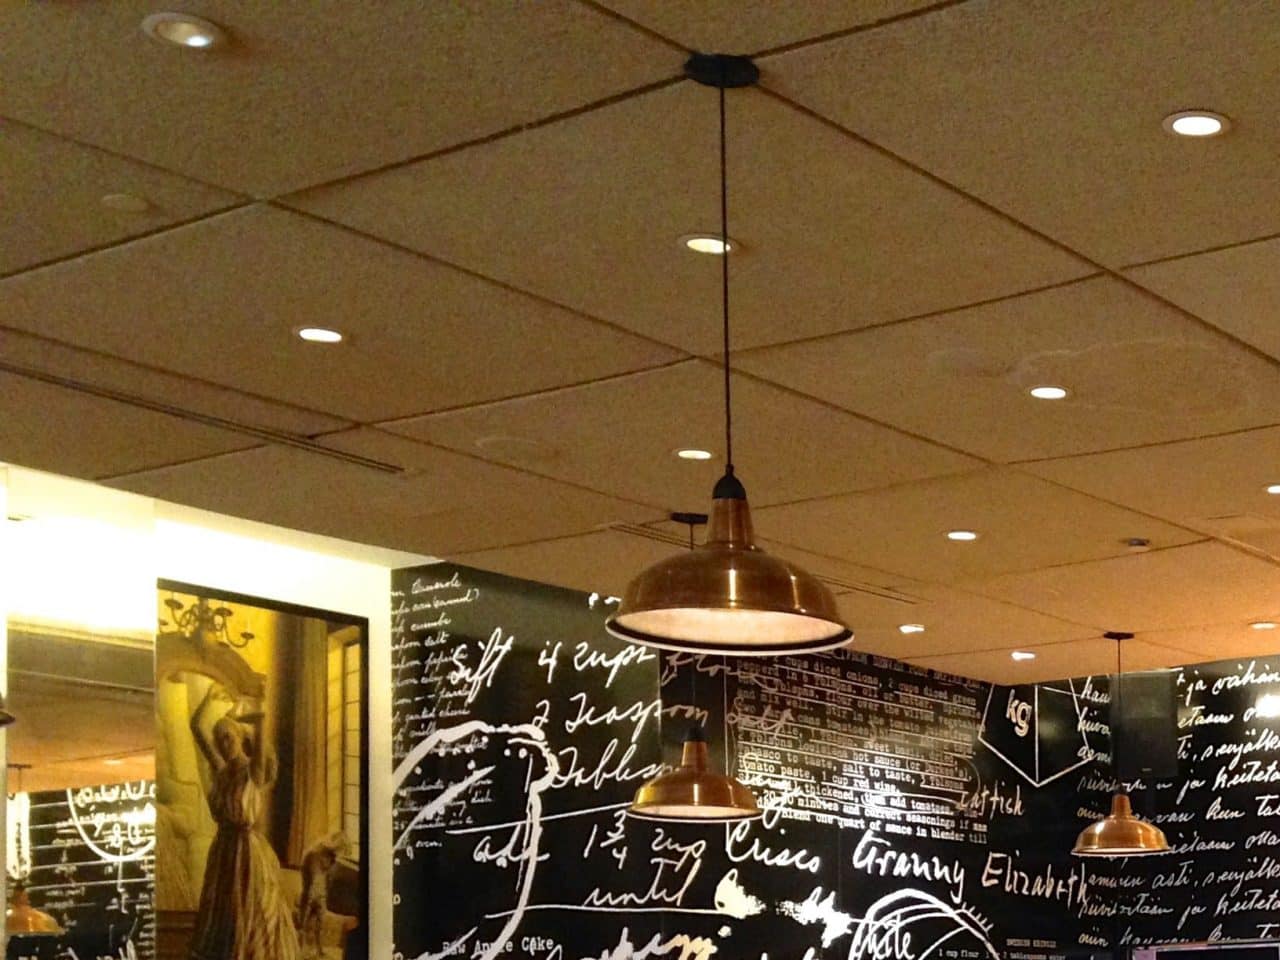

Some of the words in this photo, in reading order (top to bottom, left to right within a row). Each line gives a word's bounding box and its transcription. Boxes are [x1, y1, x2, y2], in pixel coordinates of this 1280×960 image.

[1005, 687, 1034, 739] kg
[780, 764, 816, 783] paste,
[831, 773, 850, 787] cup
[868, 766, 880, 778] to
[884, 769, 916, 785] taste,
[851, 831, 967, 903] Granny
[521, 936, 555, 956] Cake
